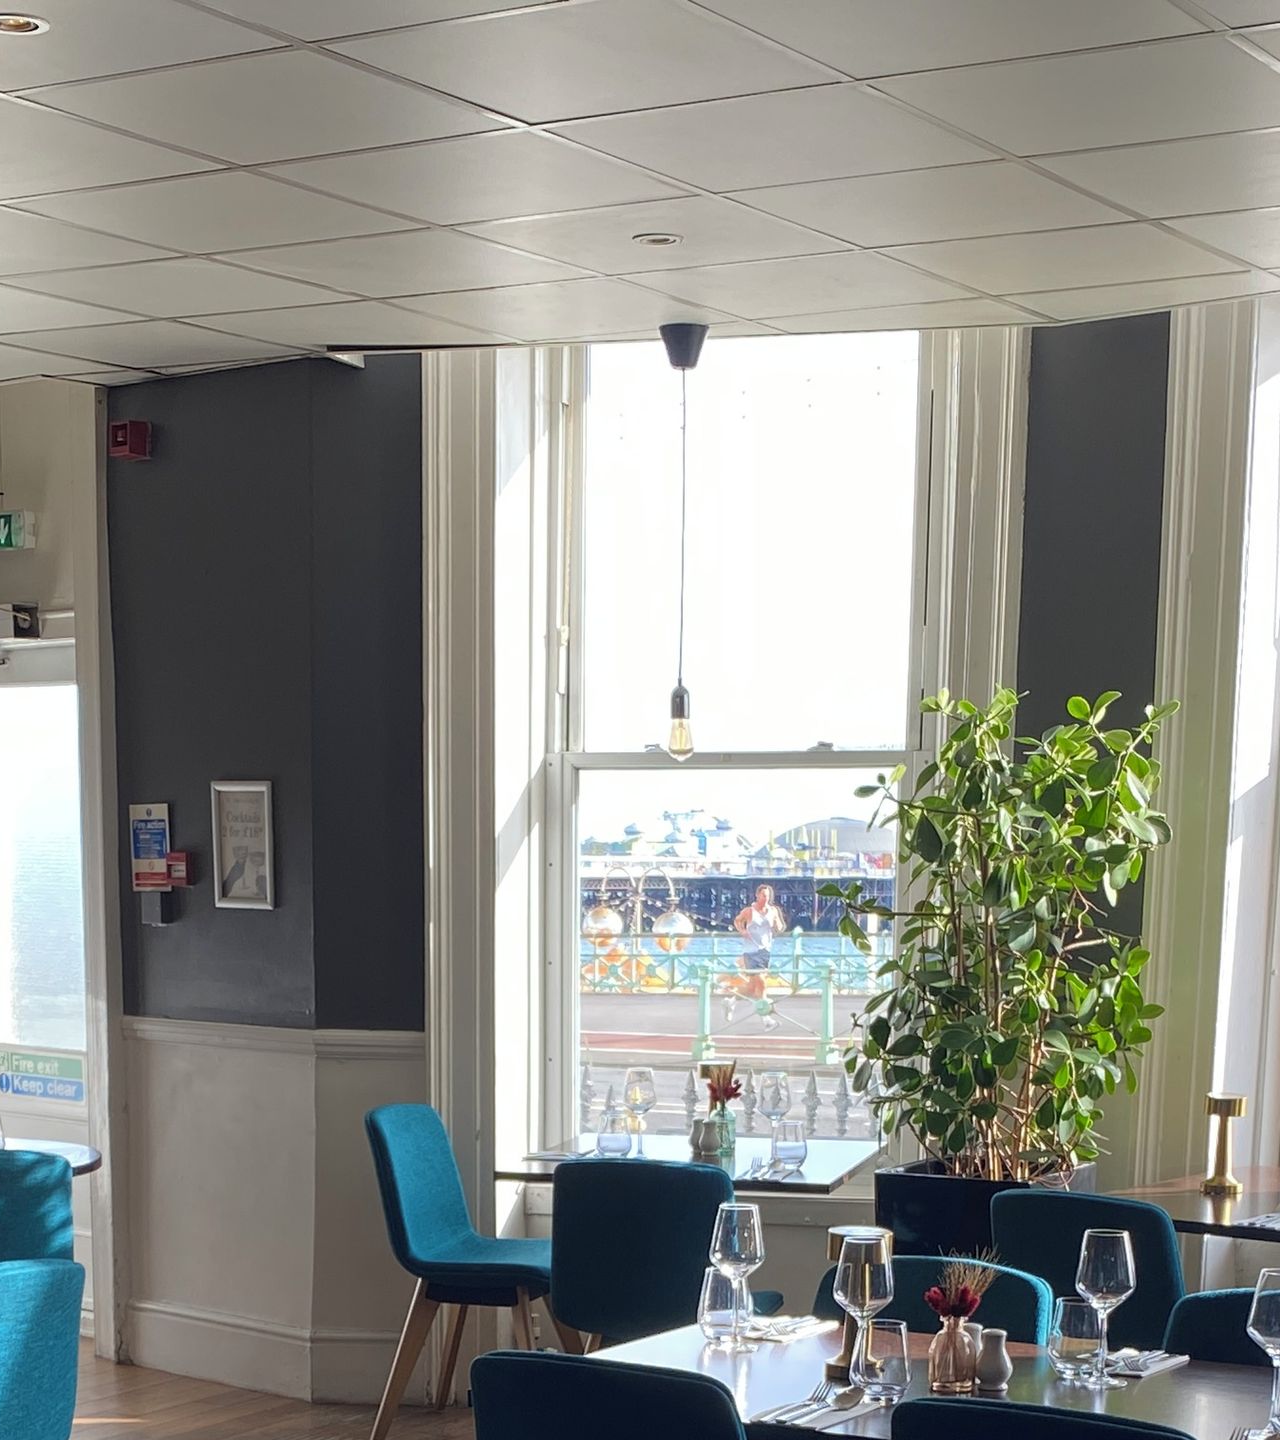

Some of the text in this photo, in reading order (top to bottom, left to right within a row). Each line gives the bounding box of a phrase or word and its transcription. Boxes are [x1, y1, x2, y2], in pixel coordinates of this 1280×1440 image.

[226, 811, 261, 823] Cocktails
[133, 820, 165, 829] Fire action
[222, 826, 227, 837] 2
[229, 826, 240, 837] for
[12, 1055, 59, 1075] Fire exit
[13, 1075, 77, 1097] Keep clear
